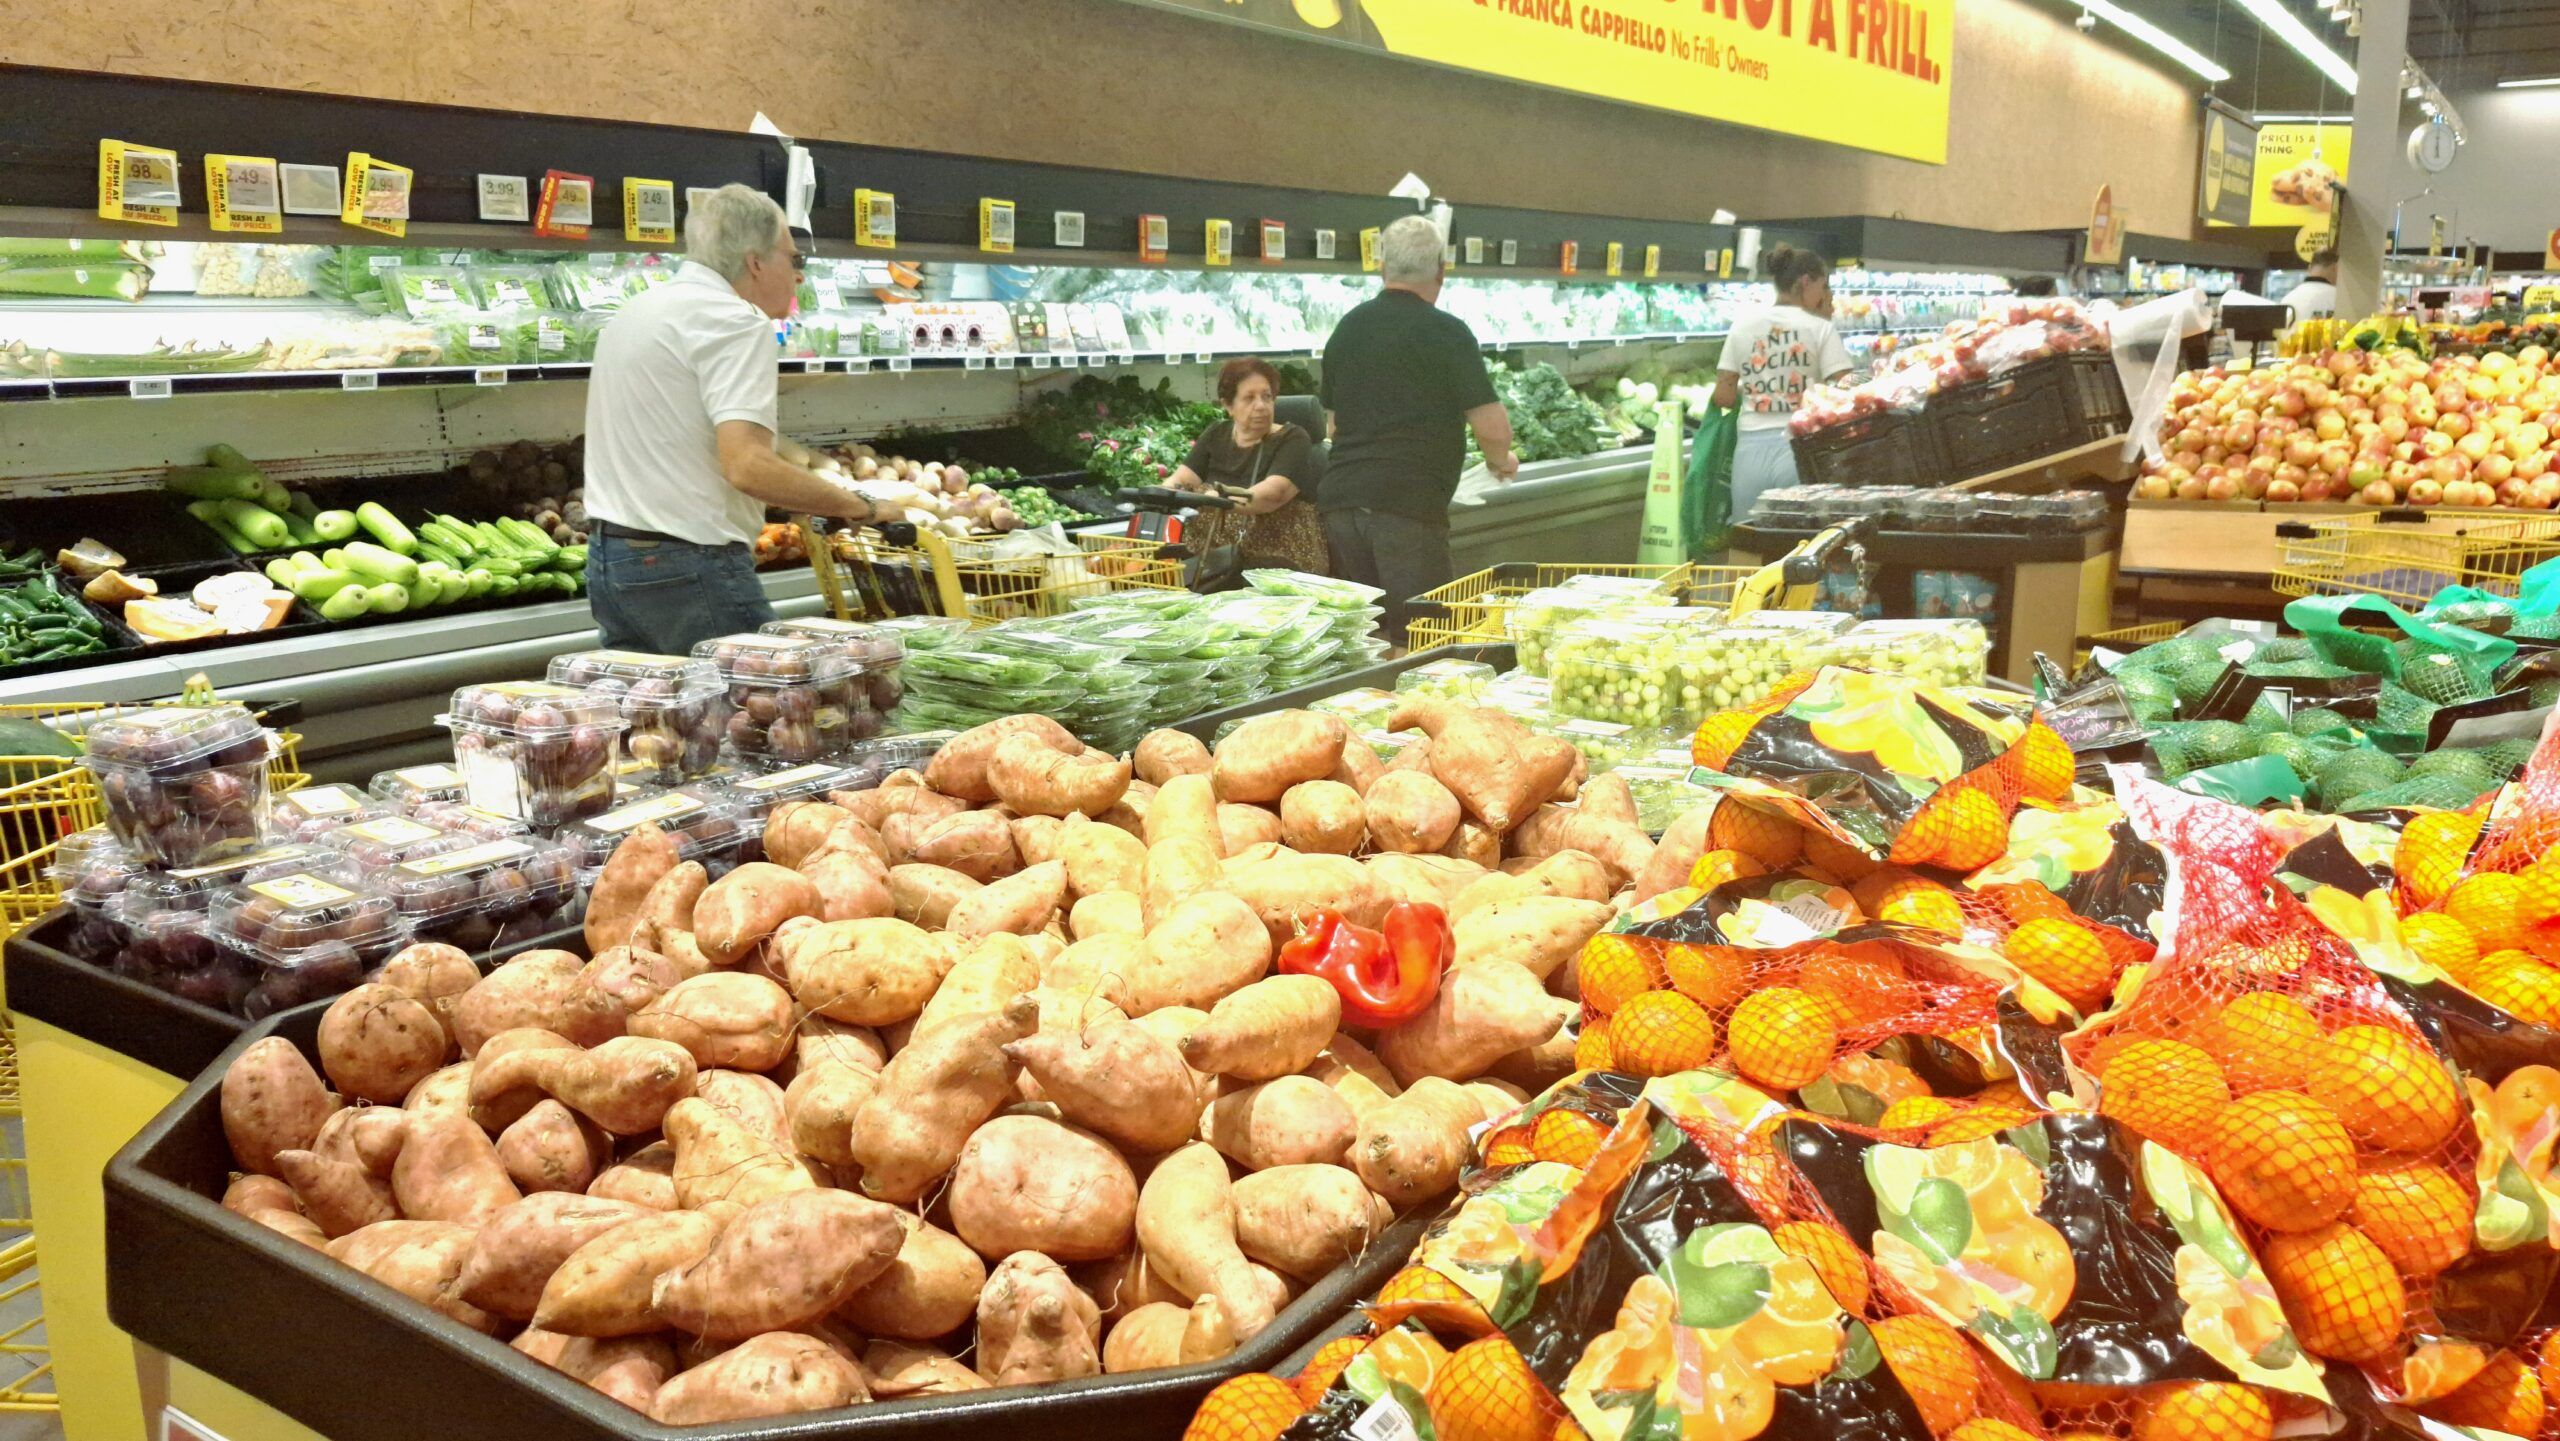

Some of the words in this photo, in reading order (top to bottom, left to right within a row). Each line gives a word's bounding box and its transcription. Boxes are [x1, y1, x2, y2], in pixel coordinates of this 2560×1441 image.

[1580, 5, 1666, 54] CAPPIELLO
[1670, 29, 1690, 60] No
[1727, 45, 1769, 81] Owners
[1808, 0, 1837, 52] A
[1845, 0, 1941, 84] FRILL.
[2261, 134, 2289, 143] PRICE
[2295, 134, 2305, 143] IS
[2309, 134, 2316, 143] A
[105, 176, 113, 206] PRICES
[112, 190, 119, 200] AT
[217, 173, 225, 200] FRESH
[213, 190, 221, 218] PRICES
[220, 203, 226, 213] AT
[1741, 351, 1810, 376] SOCIAL
